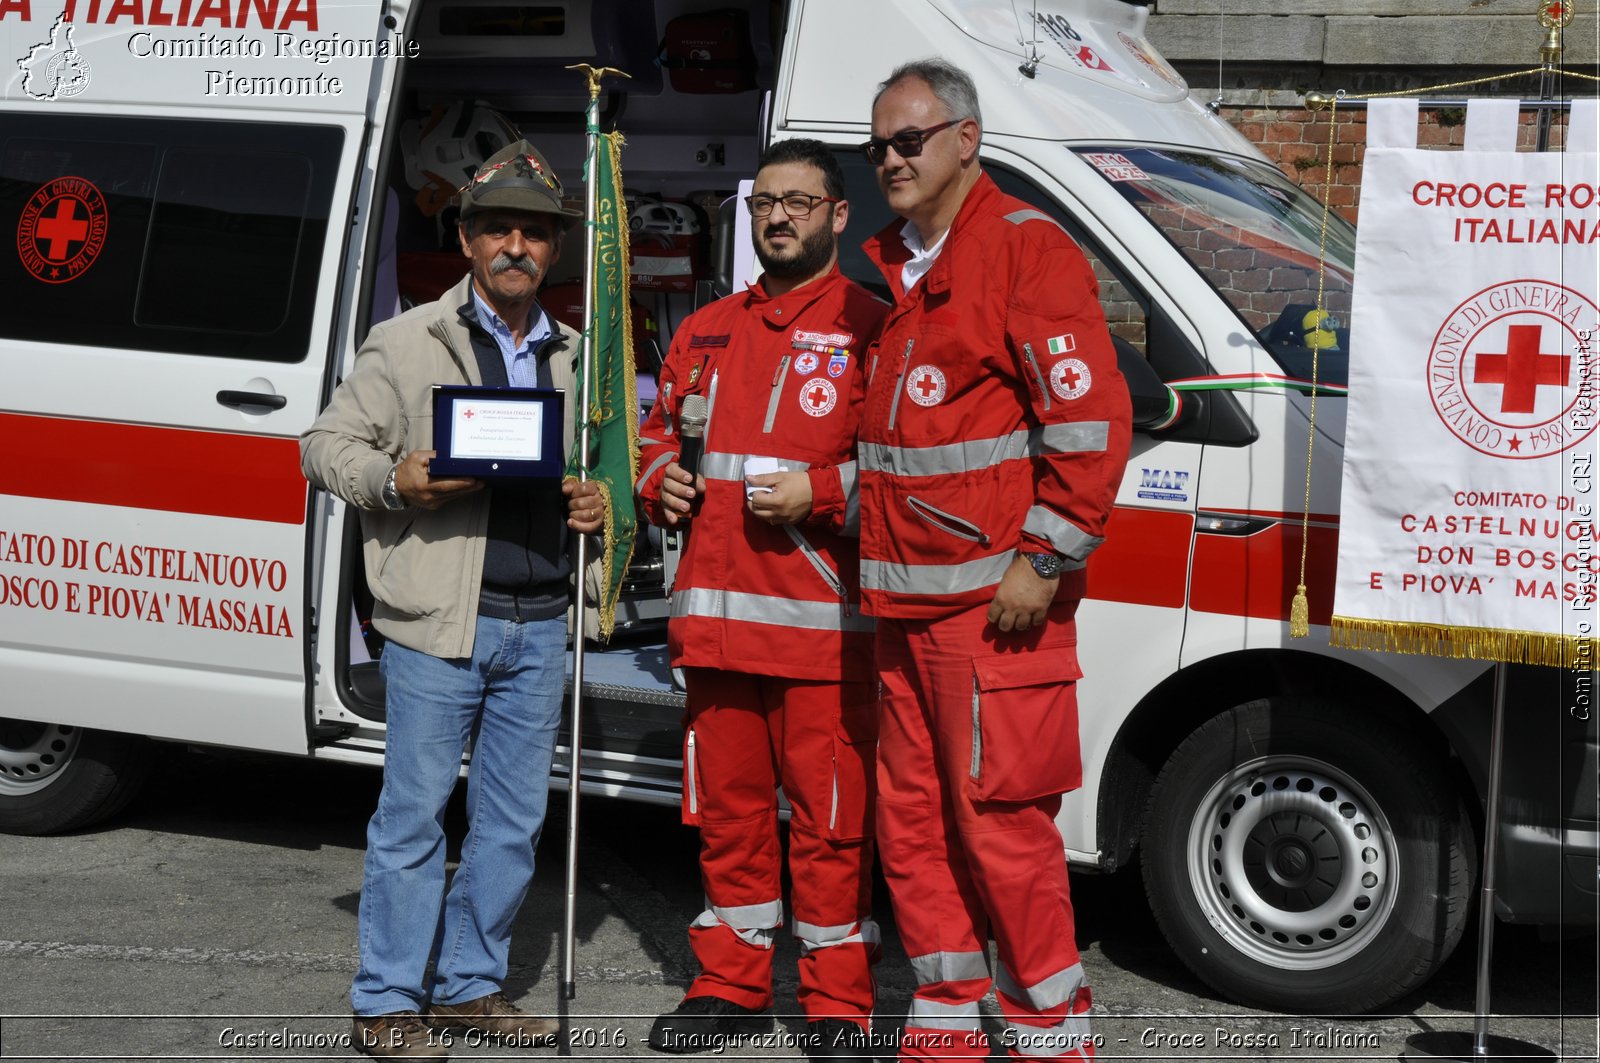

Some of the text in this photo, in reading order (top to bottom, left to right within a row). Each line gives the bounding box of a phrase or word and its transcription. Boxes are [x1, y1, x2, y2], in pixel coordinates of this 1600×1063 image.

[1104, 168, 1147, 180] 12-25
[1412, 181, 1600, 209] CROCE RO
[21, 180, 105, 276] CONVENZIONE DI GINEVRA 22 AGOSTO 1864
[1433, 285, 1583, 449] CONVENZIONE DI GINEVRA
[1529, 420, 1572, 450] 1864
[1139, 468, 1189, 490] MAF
[1454, 491, 1574, 511] COMITATO DI
[61, 537, 89, 571] DI
[95, 541, 287, 592] CASTELNUOVO
[1417, 545, 1474, 565] DON
[1370, 572, 1383, 590] E
[65, 582, 80, 613] E
[87, 584, 170, 623] PIOVA'
[177, 594, 294, 638] MASSAIA
